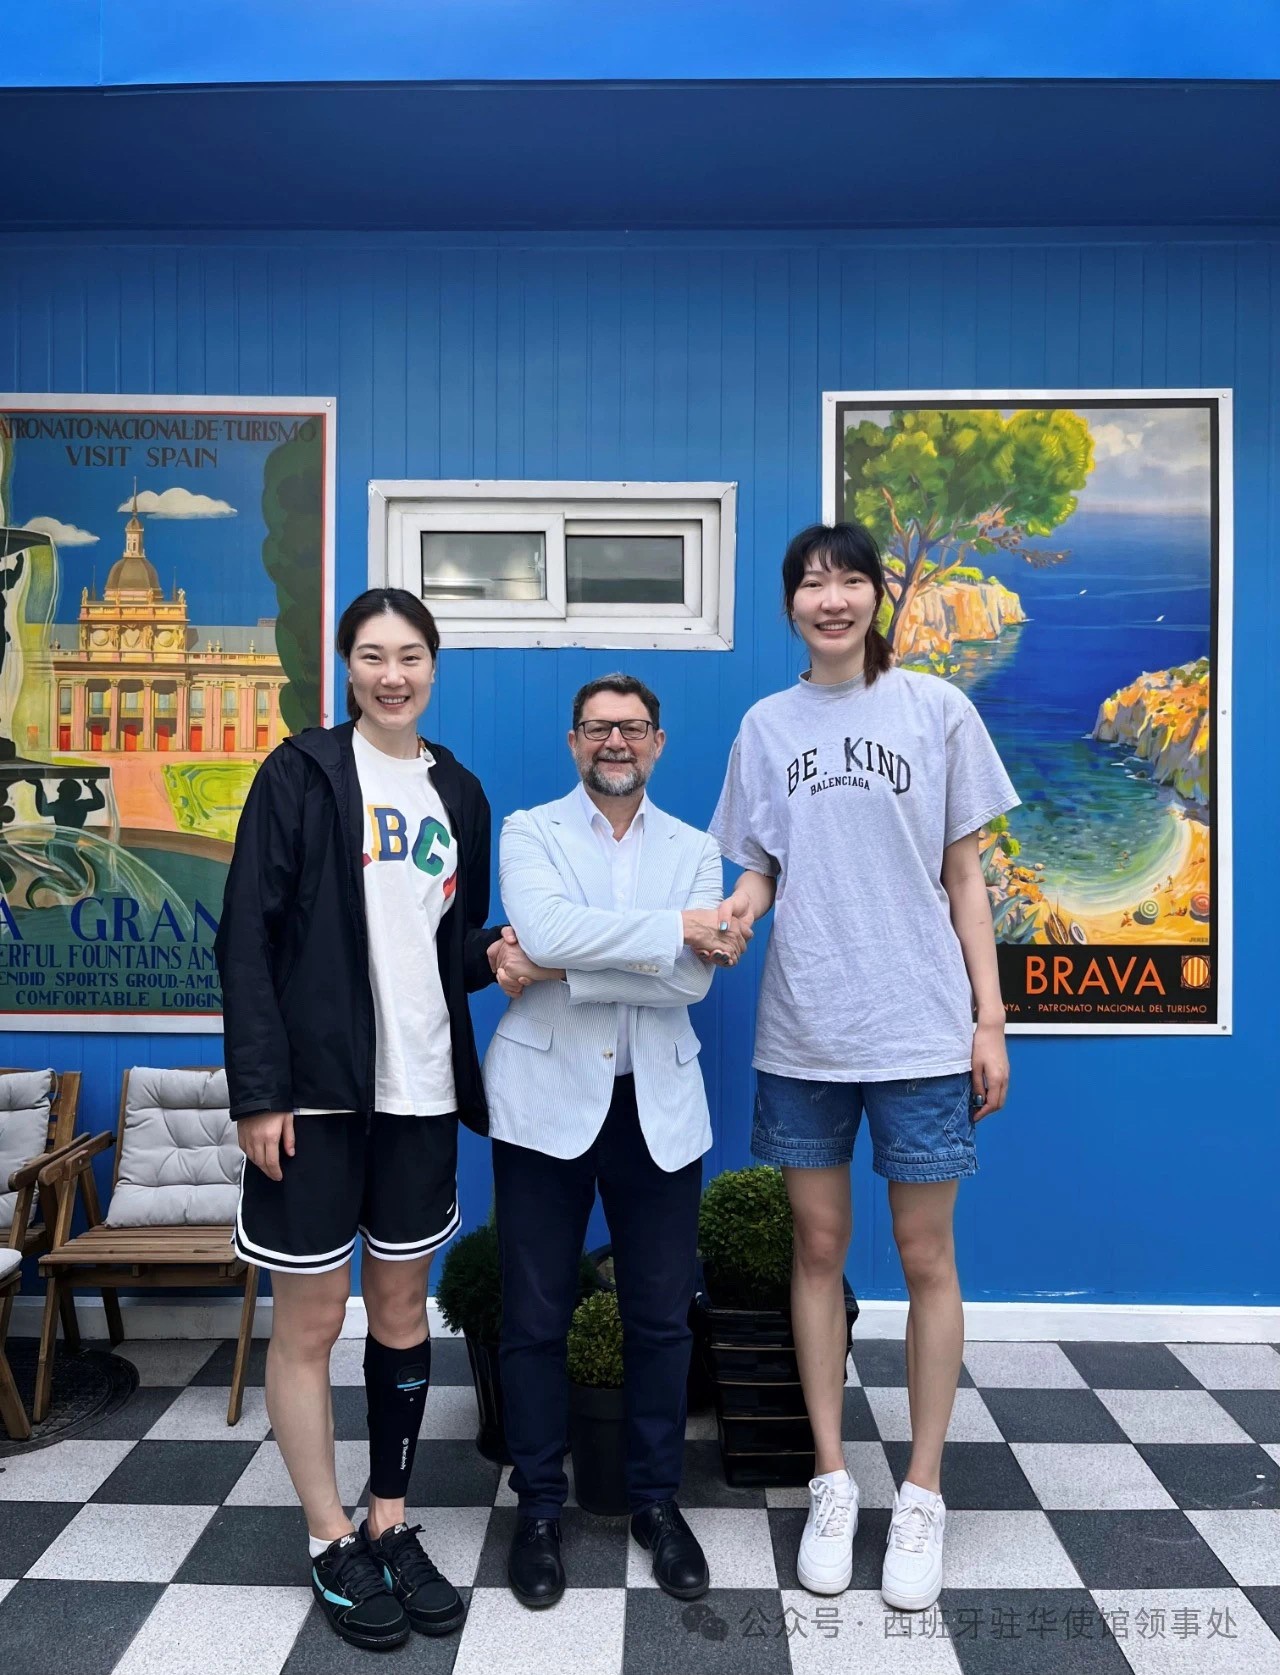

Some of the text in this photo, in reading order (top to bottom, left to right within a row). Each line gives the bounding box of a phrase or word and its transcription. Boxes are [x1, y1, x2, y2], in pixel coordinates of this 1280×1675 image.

[96, 417, 193, 440] NACIONAL
[195, 419, 219, 441] DE
[223, 419, 317, 442] TURISMO
[65, 445, 217, 468] VISIT SPAIN
[844, 736, 911, 795] KIND
[810, 775, 870, 796] BALENCIAGA
[363, 804, 457, 901] BC
[67, 944, 182, 970] FOUNTAINS
[187, 946, 219, 970] AN
[55, 971, 119, 987] SPORTS
[1026, 955, 1166, 996] BRAVA
[16, 990, 150, 1007] COMFORTABLE
[1038, 1003, 1093, 1013] PATRONATO
[1096, 1003, 1146, 1014] NACIONAL
[1149, 1003, 1164, 1014] DEL
[1167, 1003, 1208, 1014] TURISMO
